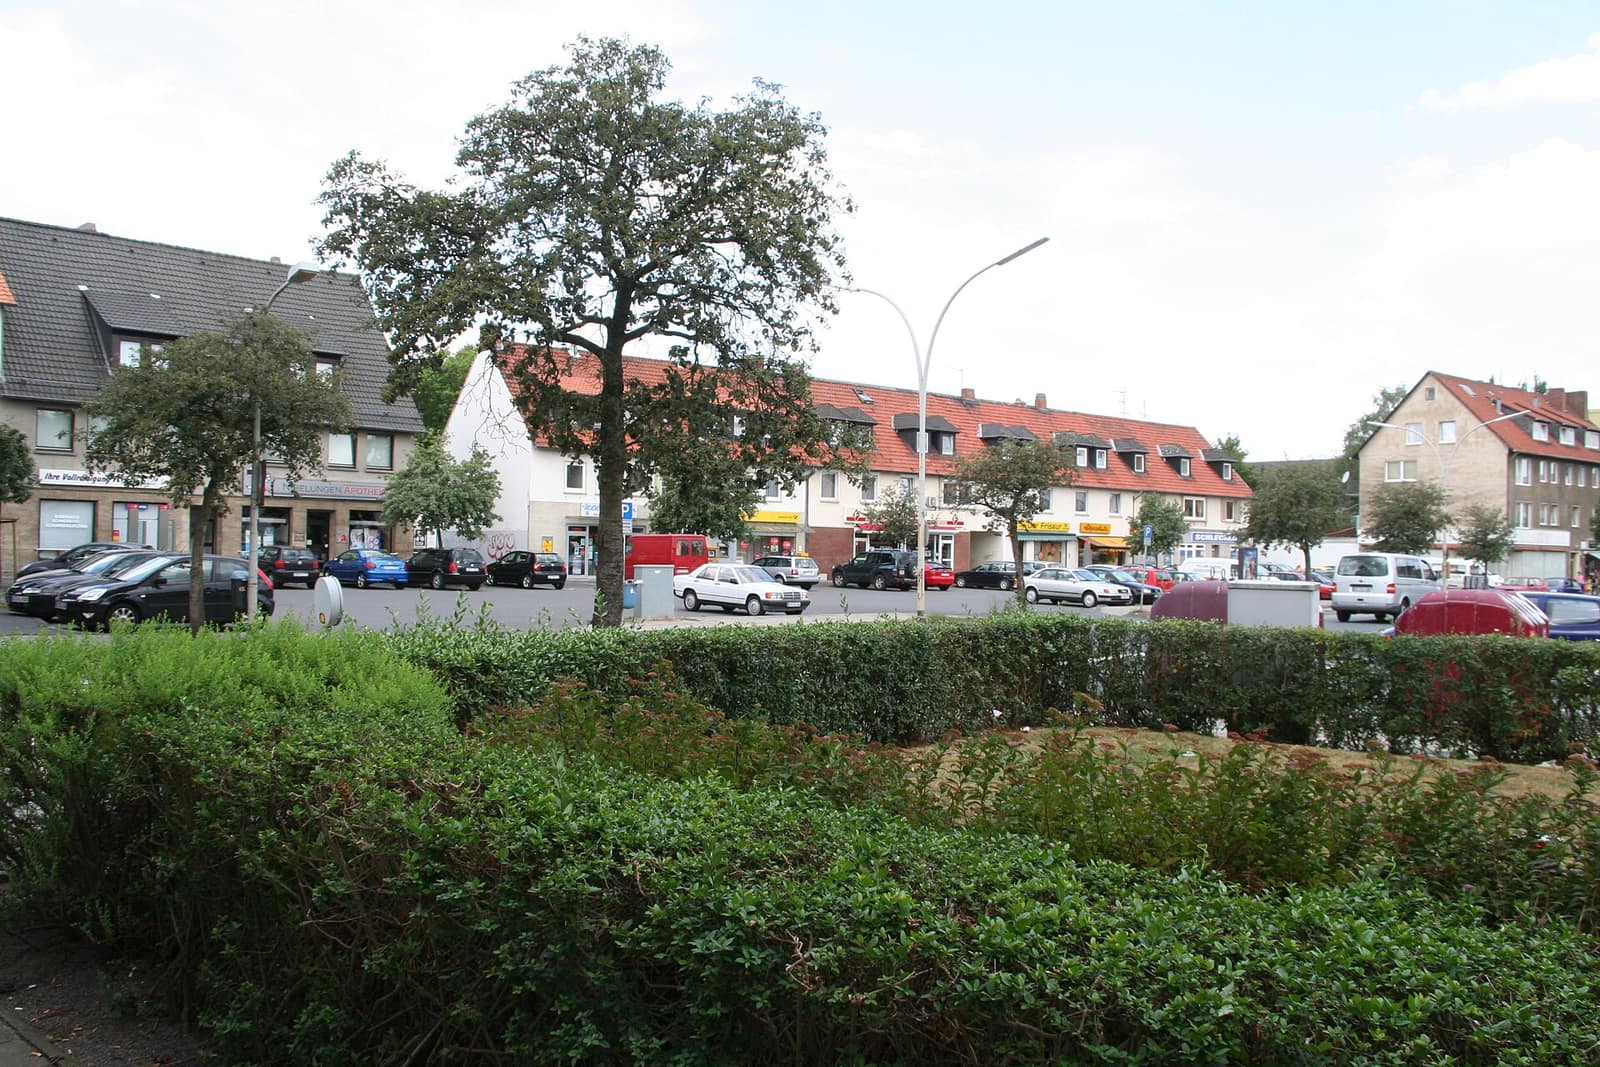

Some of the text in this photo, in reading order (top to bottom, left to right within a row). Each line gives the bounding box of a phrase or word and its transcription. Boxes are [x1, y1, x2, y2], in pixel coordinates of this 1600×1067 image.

[45, 472, 60, 481] Ihre
[62, 473, 111, 484] Vollrnigung
[283, 484, 341, 494] NELUNGEN
[622, 503, 630, 513] P
[1145, 527, 1151, 536] P
